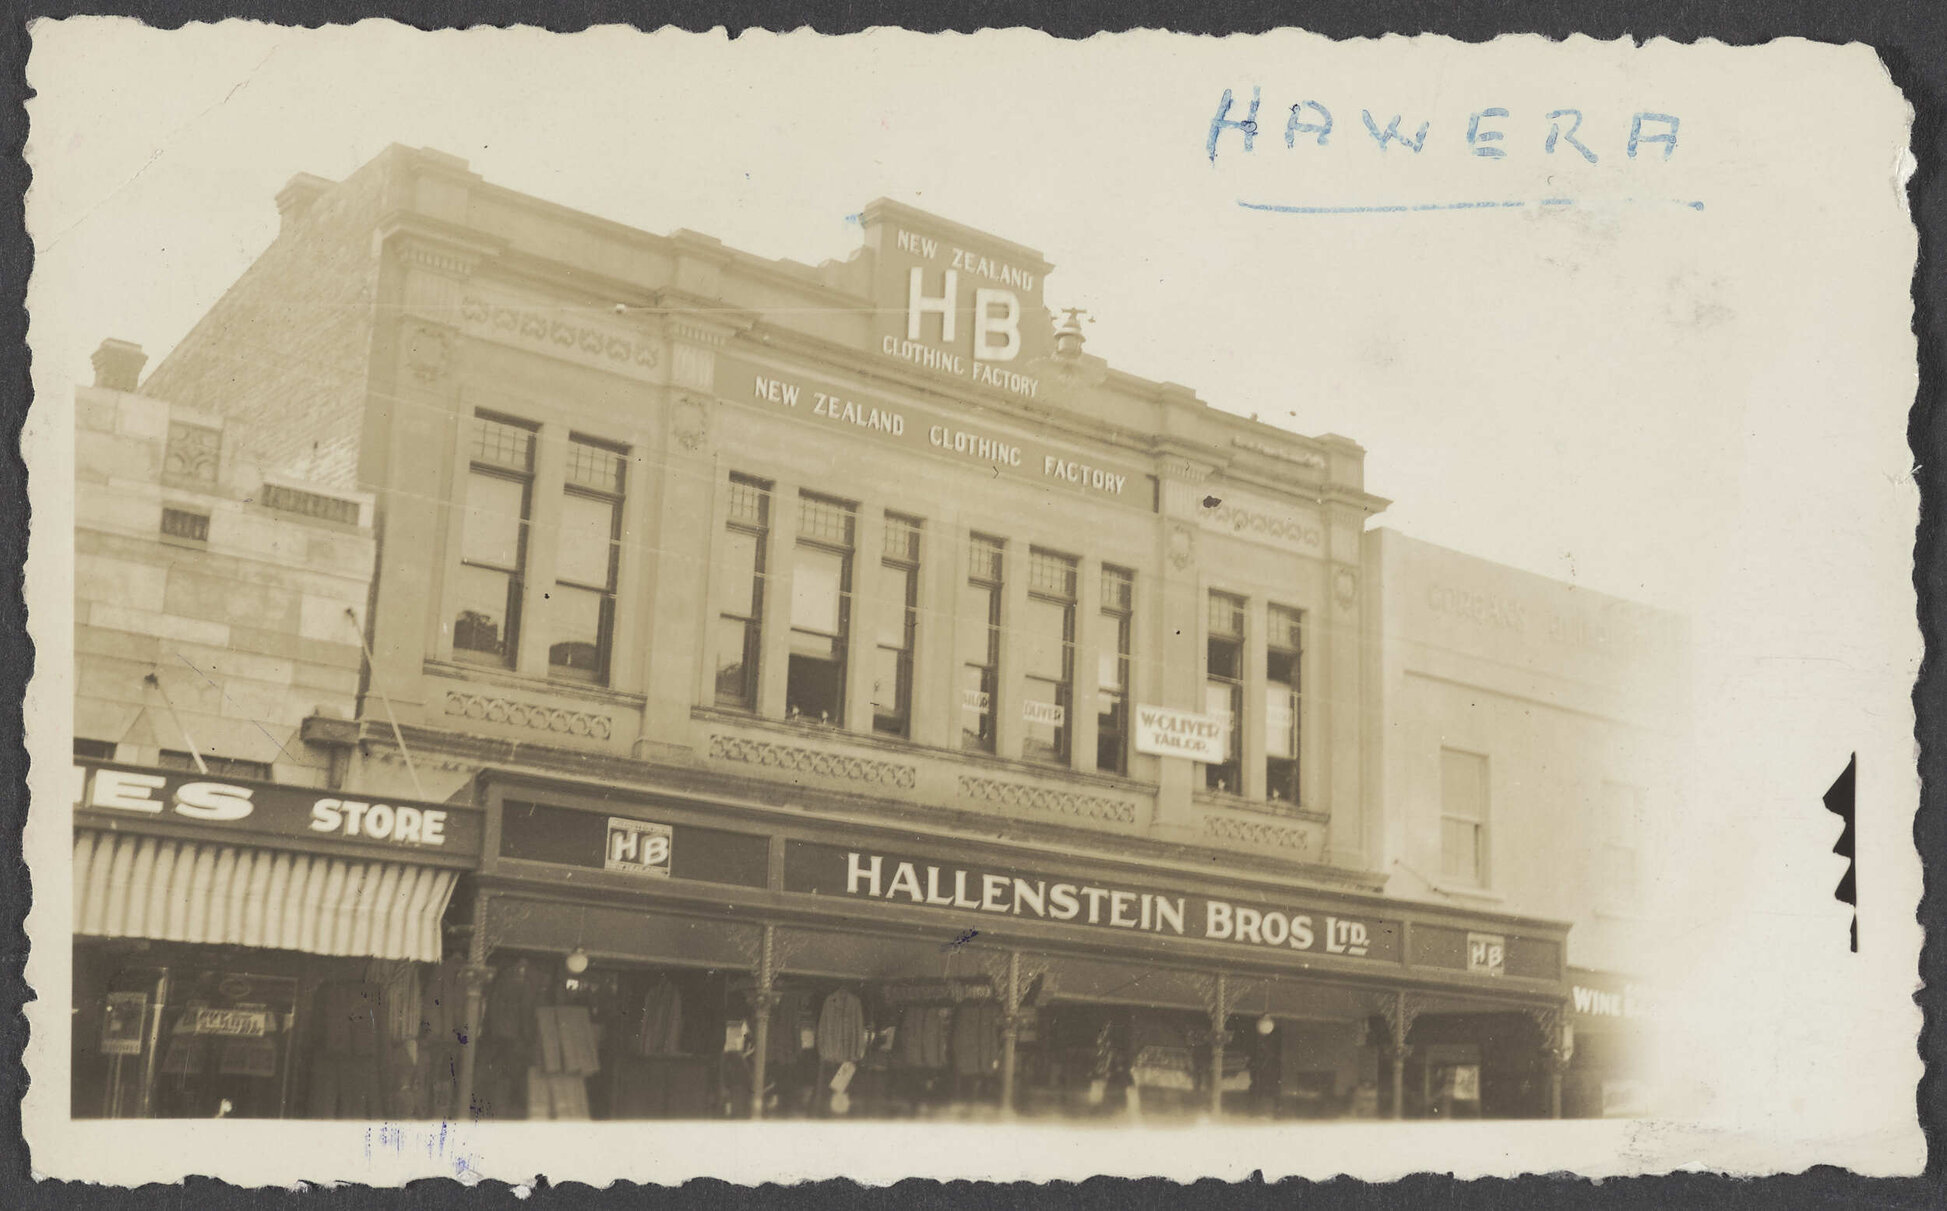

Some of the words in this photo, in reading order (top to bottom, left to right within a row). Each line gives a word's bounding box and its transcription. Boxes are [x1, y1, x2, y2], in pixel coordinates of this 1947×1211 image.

[1206, 85, 1680, 164] HAWERA
[897, 229, 937, 260] NEW
[952, 247, 1033, 293] ZEALAND
[882, 334, 964, 376] CLOTHING
[972, 361, 1039, 398] FACTORY
[754, 375, 800, 407] NEW
[812, 392, 905, 437] ZEALAND
[929, 425, 1022, 467] CLOTHING
[1043, 454, 1126, 496] FACTORY
[73, 766, 254, 821] ES
[310, 798, 447, 846] STORE
[610, 831, 669, 866] HB
[846, 852, 1185, 935] HALLENSTEIN
[1205, 900, 1314, 950] BROS
